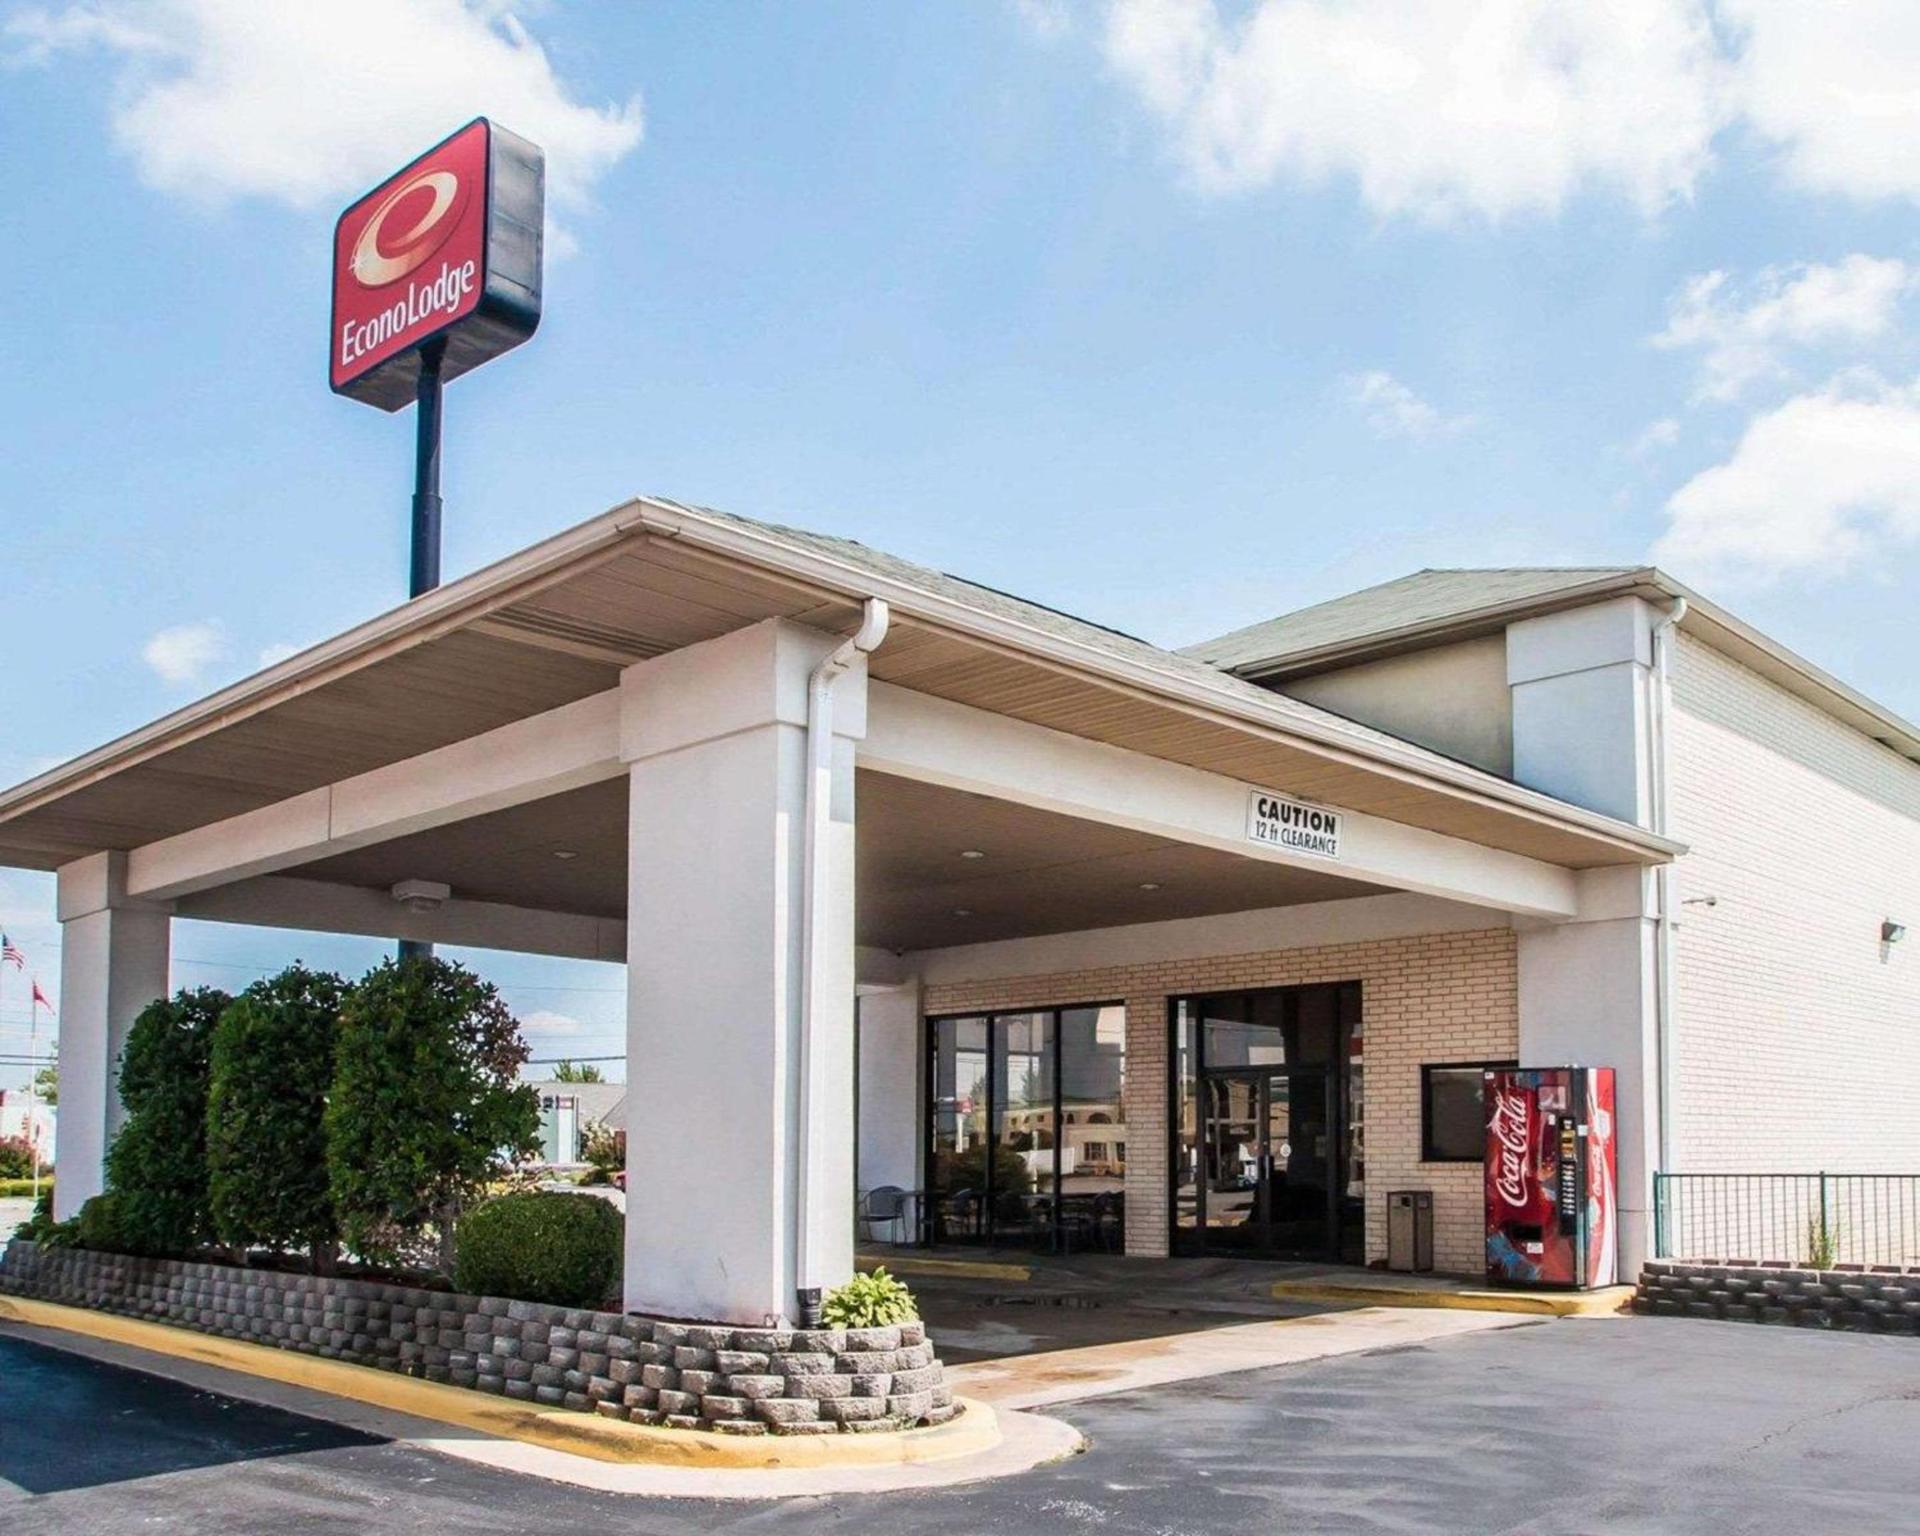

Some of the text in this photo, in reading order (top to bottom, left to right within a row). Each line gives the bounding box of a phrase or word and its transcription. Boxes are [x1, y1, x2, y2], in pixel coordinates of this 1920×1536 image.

[342, 260, 475, 366] EconoLodge
[1258, 798, 1336, 835] CAUTION
[1256, 821, 1267, 839] 12
[1281, 828, 1337, 855] CLEARANCE
